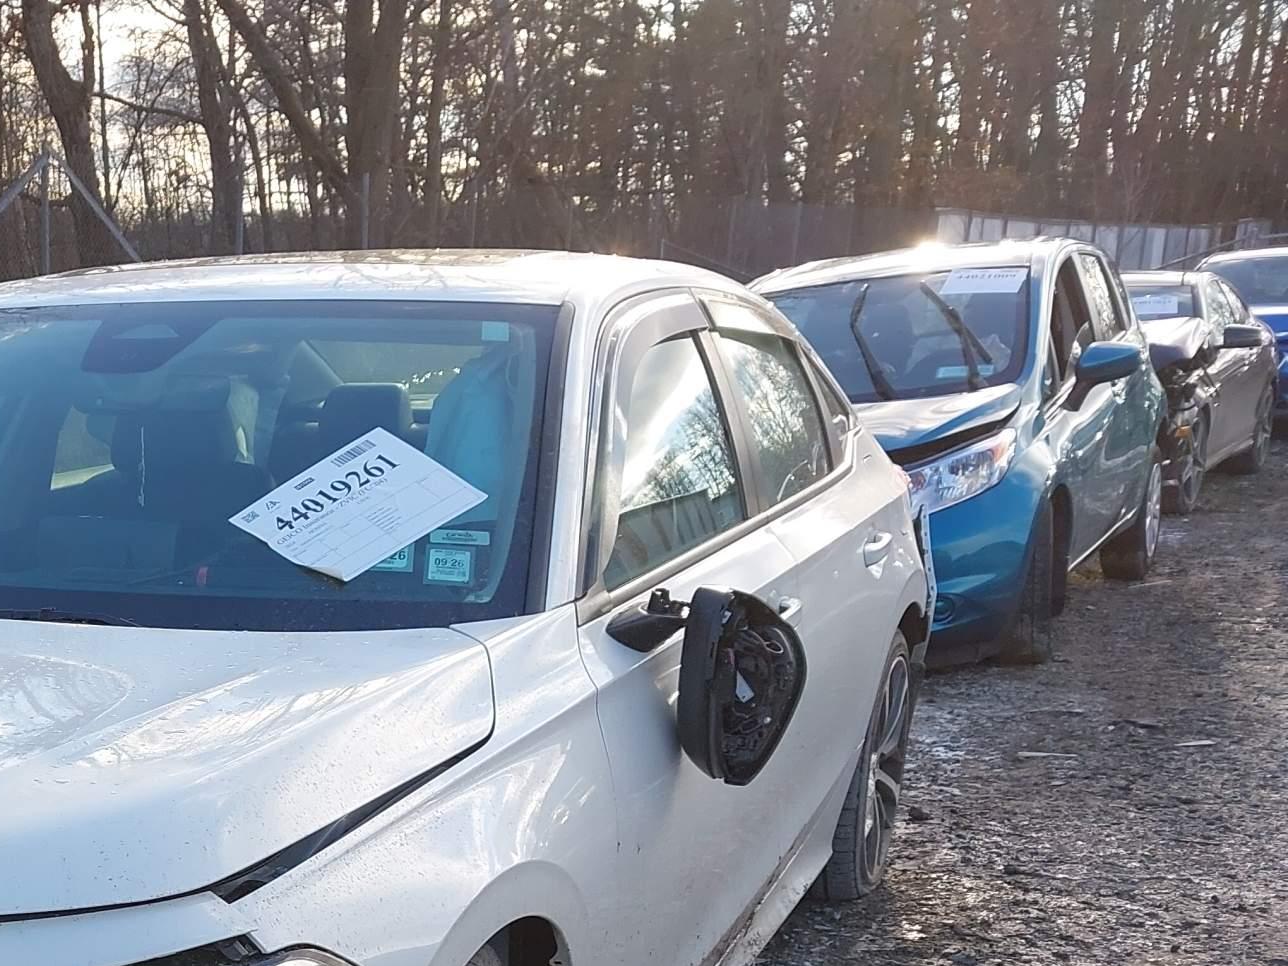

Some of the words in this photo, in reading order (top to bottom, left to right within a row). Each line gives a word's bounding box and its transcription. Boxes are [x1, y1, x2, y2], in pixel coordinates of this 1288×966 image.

[275, 453, 401, 532] 44019261
[277, 527, 303, 546] GEICO
[434, 557, 448, 566] 09
[450, 558, 465, 567] 26
